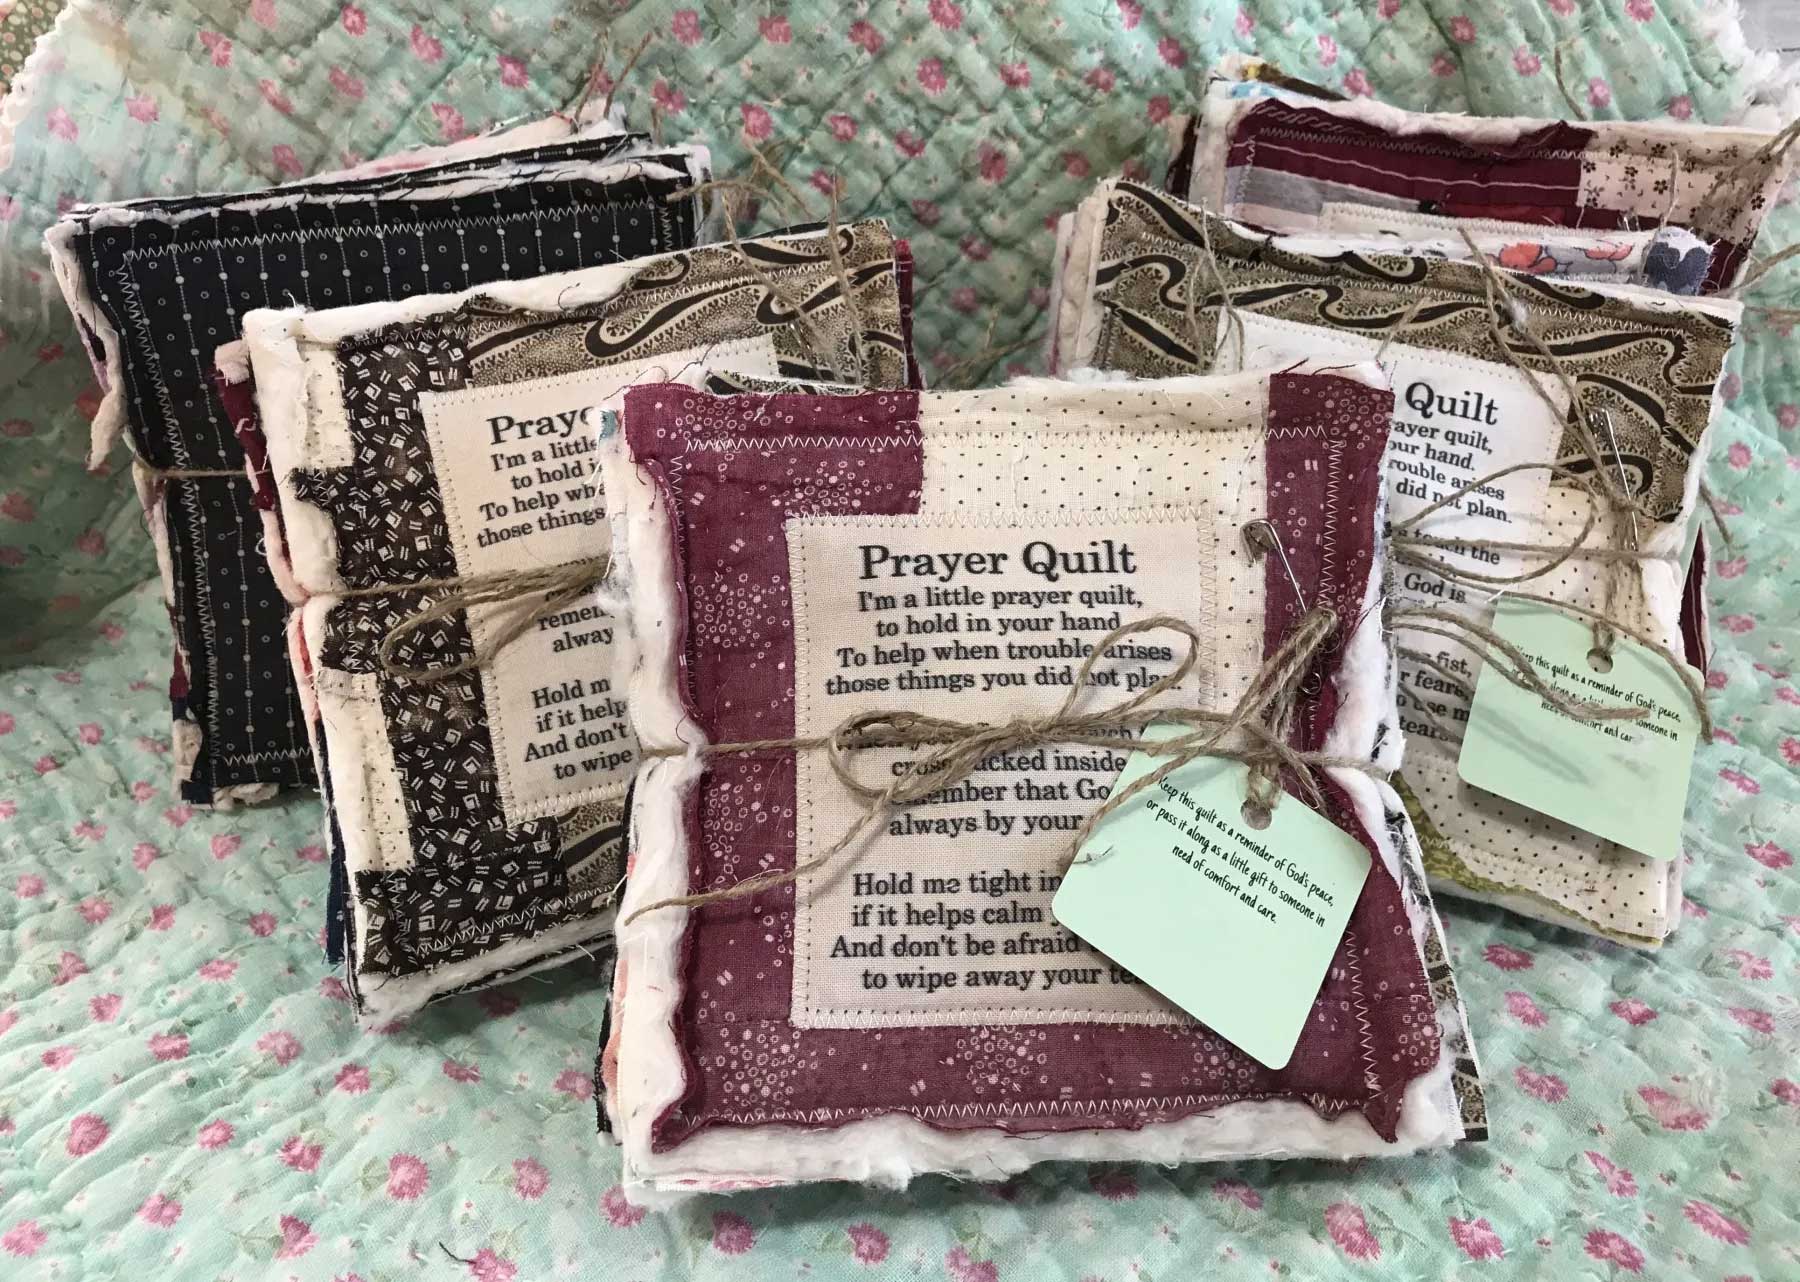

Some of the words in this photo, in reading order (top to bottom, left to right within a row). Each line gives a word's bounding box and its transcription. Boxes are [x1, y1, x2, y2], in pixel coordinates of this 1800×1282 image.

[1406, 382, 1498, 425] Quilt
[1424, 443, 1475, 470] hand.
[1444, 430, 1492, 455] quilt,
[491, 453, 526, 471] I'm
[532, 449, 545, 462] a
[511, 475, 533, 490] to
[538, 461, 584, 484] hold
[480, 502, 508, 521] To
[513, 488, 560, 513] help
[1396, 479, 1426, 500] did
[1467, 499, 1512, 523] plan.
[477, 522, 533, 547] those
[538, 507, 605, 526] things
[858, 545, 1008, 582] Prayer
[1023, 541, 1137, 583] Quilt
[1471, 546, 1500, 565] the
[858, 591, 896, 612] I'm
[904, 594, 918, 608] a
[924, 586, 984, 607] little
[992, 587, 1072, 609] prayer
[1079, 585, 1143, 609] quilt,
[1404, 572, 1444, 596] God
[1448, 584, 1466, 603] is
[876, 619, 899, 637] to
[905, 614, 959, 636] hold
[966, 614, 990, 632] in
[998, 616, 1055, 635] your
[837, 647, 867, 669] To
[874, 644, 925, 669] help
[933, 639, 1000, 661] when
[1007, 638, 1092, 659] trouble
[1104, 639, 1172, 661] arises
[1437, 651, 1472, 678] fist,
[531, 680, 584, 709] Hold
[826, 671, 890, 695] those
[898, 671, 975, 693] things
[982, 671, 1026, 691] you
[1034, 666, 1072, 687] did
[1125, 670, 1182, 692] pla.
[1551, 665, 1570, 678] quilt
[1571, 673, 1579, 682] as
[1588, 679, 1624, 698] reminder
[1624, 692, 1634, 703] of
[536, 714, 554, 733] if
[558, 710, 575, 727] it
[1670, 728, 1678, 741] in
[525, 734, 569, 762] And
[574, 722, 629, 748] don't
[554, 762, 576, 779] to
[583, 749, 633, 772] wipe
[972, 750, 1046, 774] ucked
[1054, 747, 1126, 771] inside
[1014, 778, 1070, 802] that
[889, 813, 977, 837] always
[986, 809, 1016, 838] by
[1023, 813, 1083, 833] your
[1158, 776, 1178, 802] Keep
[1179, 789, 1196, 810] this
[1195, 806, 1217, 822] quilt
[1216, 819, 1228, 832] as
[1228, 828, 1234, 837] a
[1235, 832, 1274, 863] reminder
[1274, 858, 1287, 871] of
[1286, 863, 1310, 888] God's
[1308, 881, 1334, 907] peace,
[1146, 800, 1158, 811] or
[1156, 807, 1177, 826] pass
[1178, 819, 1188, 831] it
[1186, 825, 1210, 854] along
[1211, 843, 1222, 856] as
[1222, 852, 1228, 861] a
[1229, 852, 1250, 876] little
[1250, 871, 1268, 887] gift
[1268, 881, 1278, 895] to
[1279, 890, 1315, 920] someone
[1316, 913, 1325, 927] in
[852, 872, 913, 897] Hold
[922, 876, 961, 894] me
[968, 870, 1031, 897] tight
[1172, 845, 1194, 865] need
[1193, 859, 1206, 872] of
[1204, 866, 1240, 897] comfort
[1240, 892, 1258, 909] and
[1257, 904, 1277, 924] care.
[851, 904, 874, 927] if
[878, 906, 897, 926] it
[905, 902, 975, 930] helps
[982, 904, 1042, 924] calm
[830, 935, 884, 959] And
[892, 935, 958, 957] don't
[966, 932, 995, 955] be
[1004, 931, 1081, 954] afraid
[862, 970, 887, 990] to
[895, 968, 957, 993] wipe
[965, 970, 1036, 991] away
[1042, 970, 1103, 992] your
